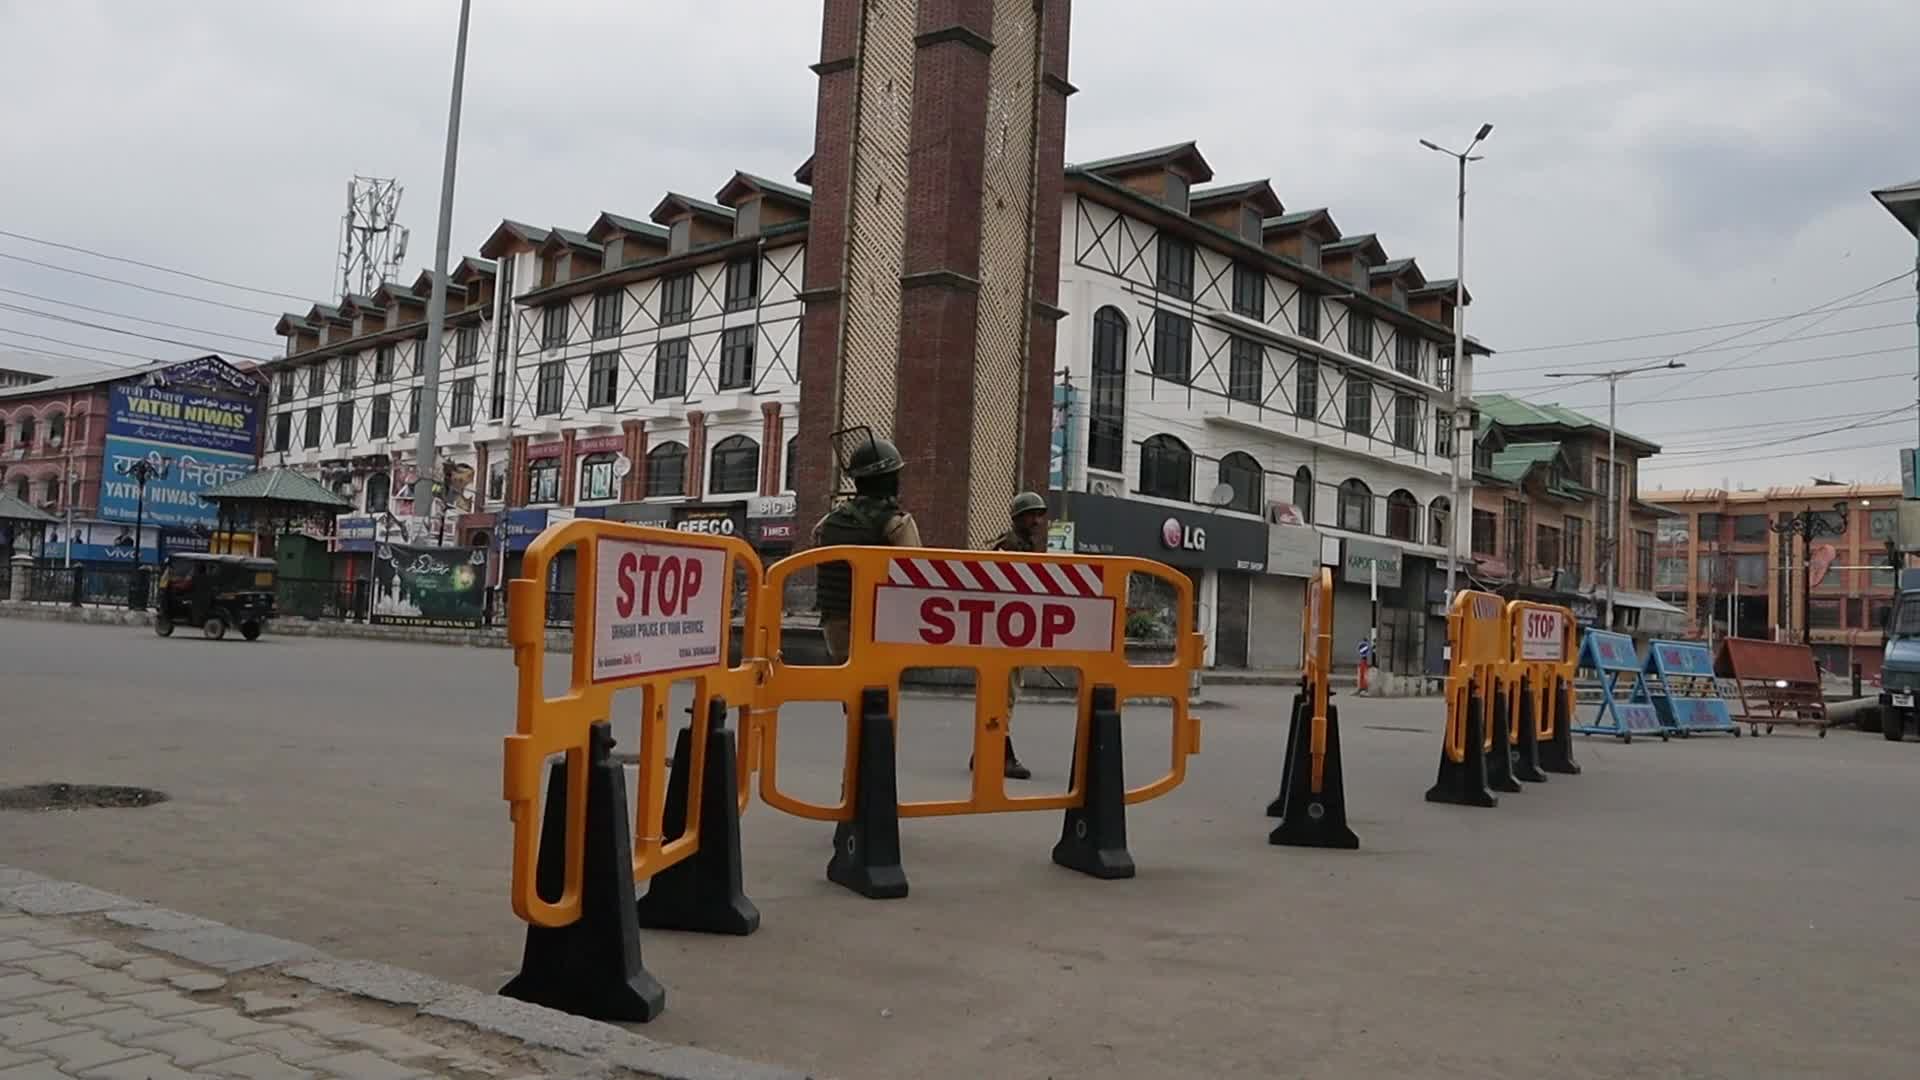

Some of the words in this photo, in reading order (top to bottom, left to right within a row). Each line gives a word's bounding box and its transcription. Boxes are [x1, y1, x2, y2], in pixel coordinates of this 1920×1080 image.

[128, 397, 181, 418] YATRI
[184, 405, 246, 429] NIWAS
[151, 487, 198, 506] NIWAS
[1183, 525, 1206, 551] LG
[616, 551, 703, 618] STOP
[638, 622, 658, 638] POLICE
[919, 597, 1076, 648] STOP
[1527, 612, 1555, 639] STOP
